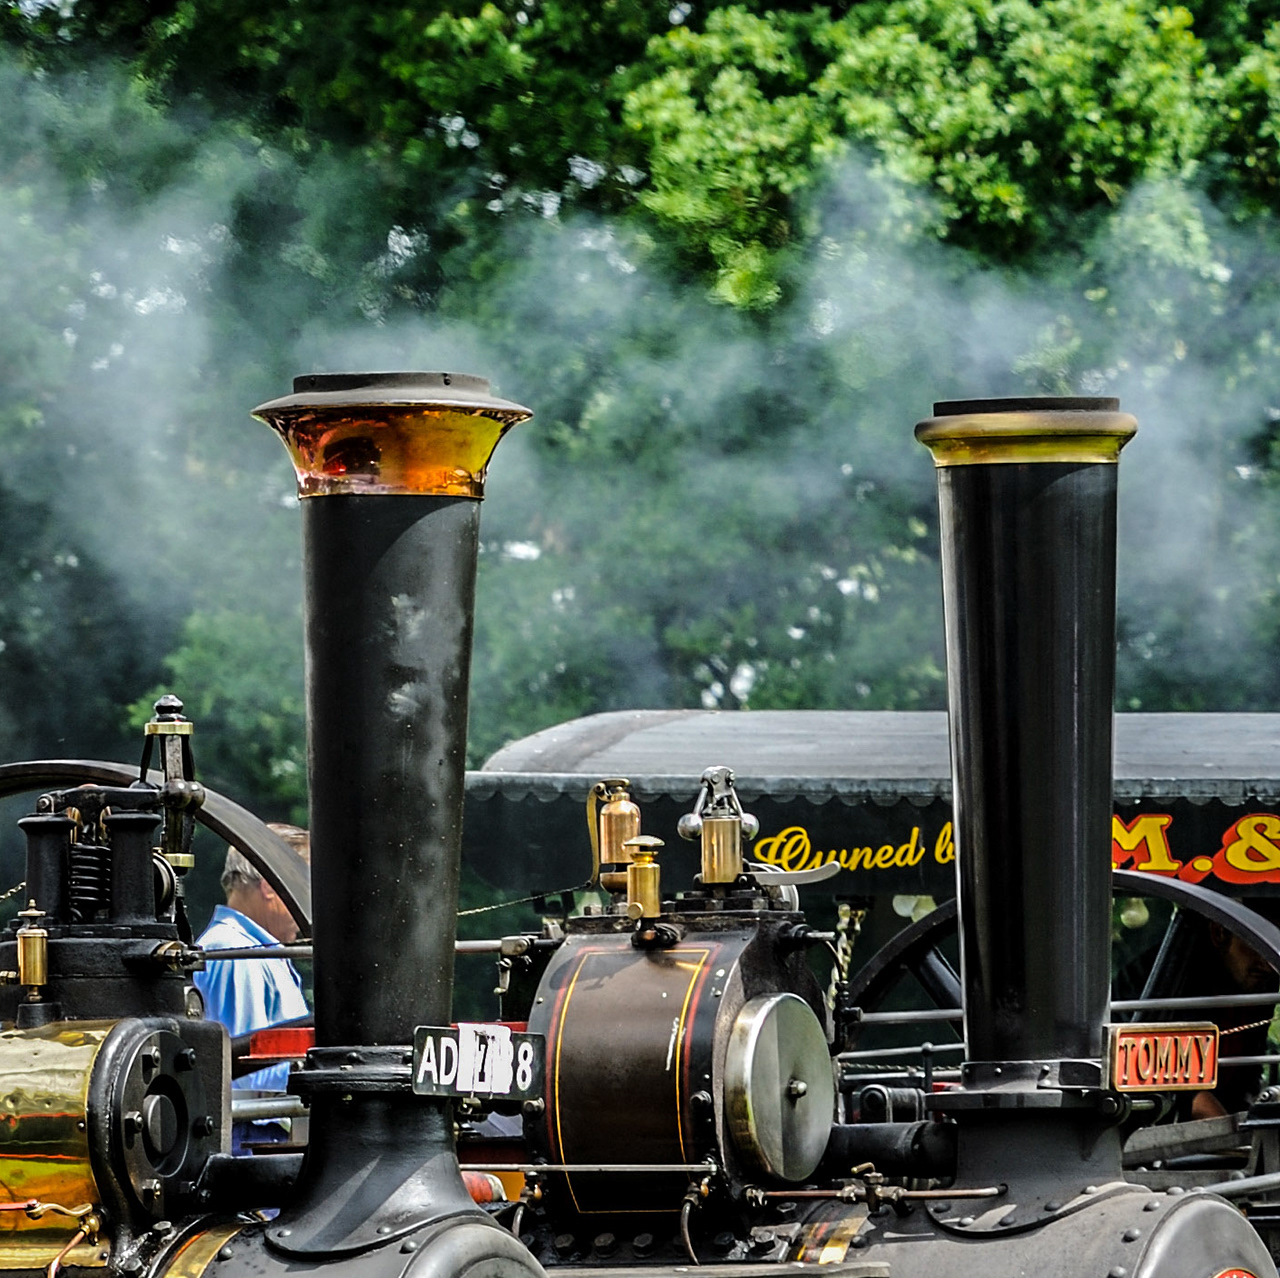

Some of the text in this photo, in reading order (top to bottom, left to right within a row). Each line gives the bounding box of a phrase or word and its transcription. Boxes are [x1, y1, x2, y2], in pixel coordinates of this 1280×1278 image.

[754, 826, 925, 871] Owned
[417, 1036, 459, 1086] AD
[1119, 1034, 1215, 1081] TOMMY
